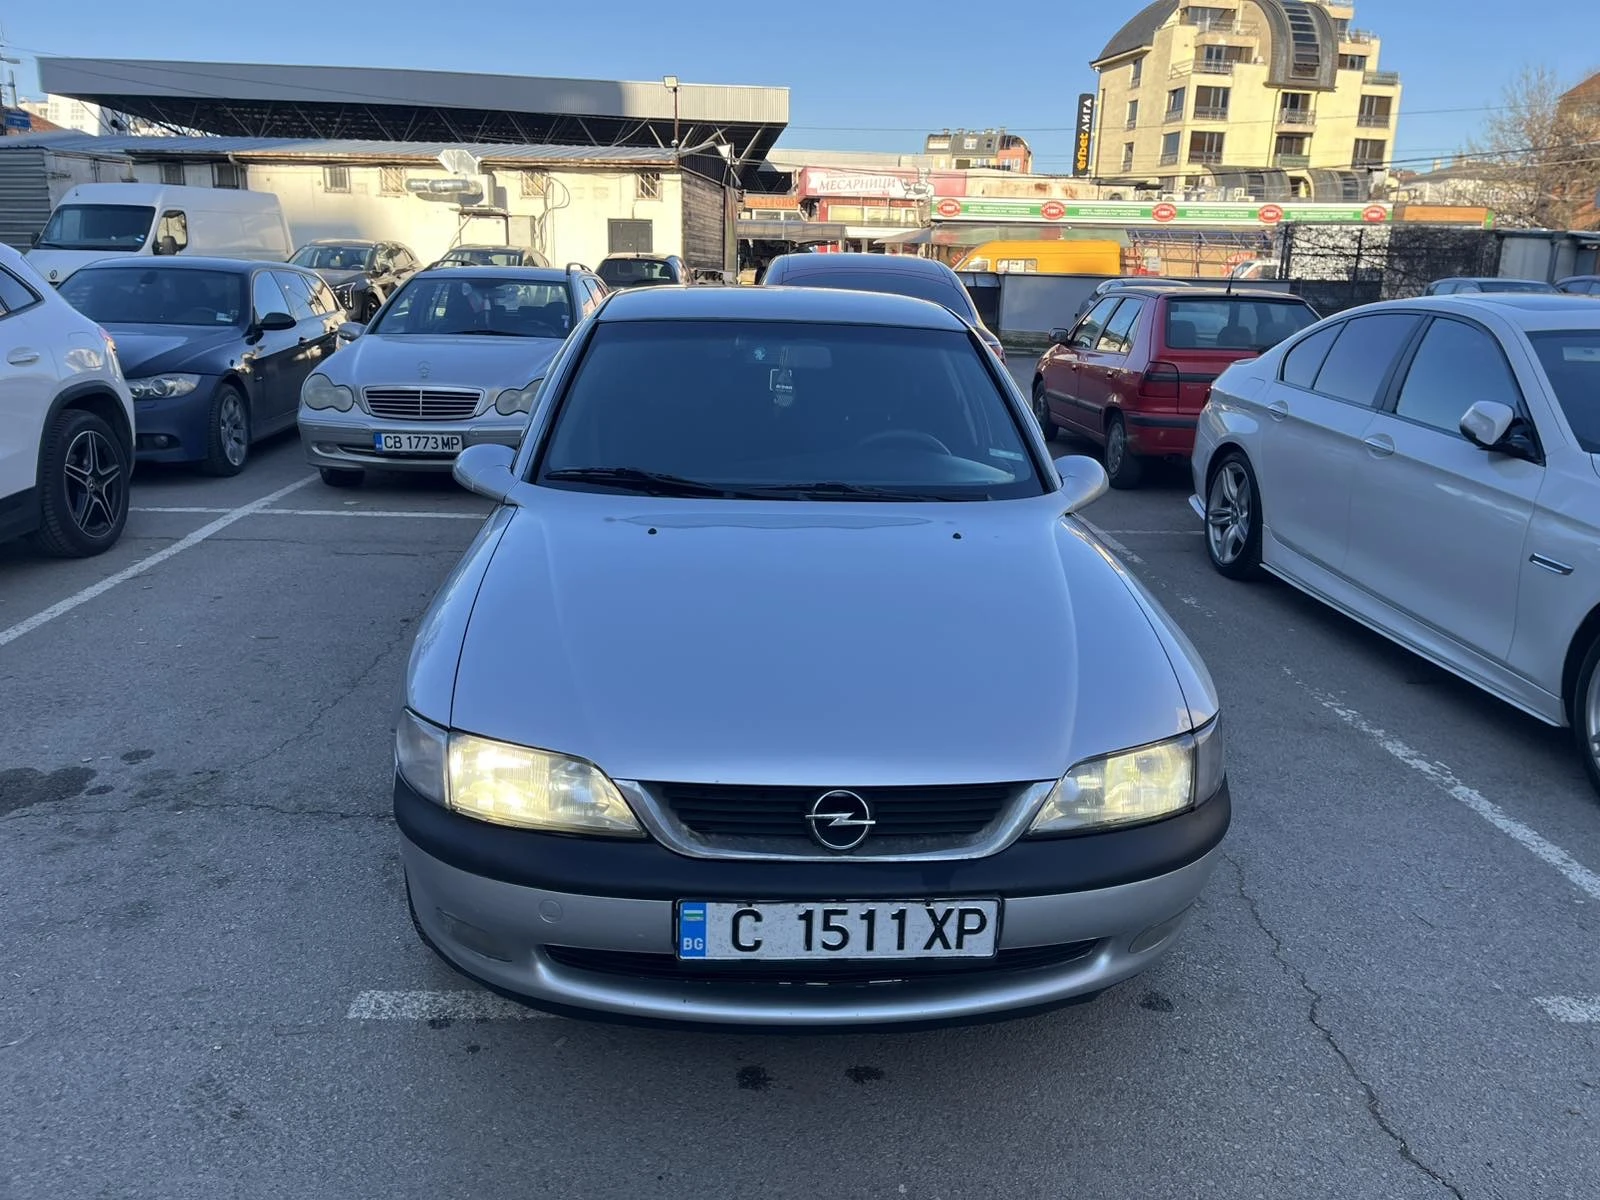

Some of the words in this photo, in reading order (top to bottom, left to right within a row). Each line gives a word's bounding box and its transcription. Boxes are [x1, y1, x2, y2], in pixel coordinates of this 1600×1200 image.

[1081, 98, 1092, 132] ЛИГА
[1077, 132, 1089, 170] efbet
[819, 178, 896, 192] МЕСАРНИЦИ
[384, 435, 403, 449] CB
[406, 435, 439, 450] 1773
[441, 436, 460, 450] MP
[731, 907, 763, 952] C
[797, 907, 906, 951] 1511
[922, 906, 987, 951] XP
[682, 937, 704, 951] BG
